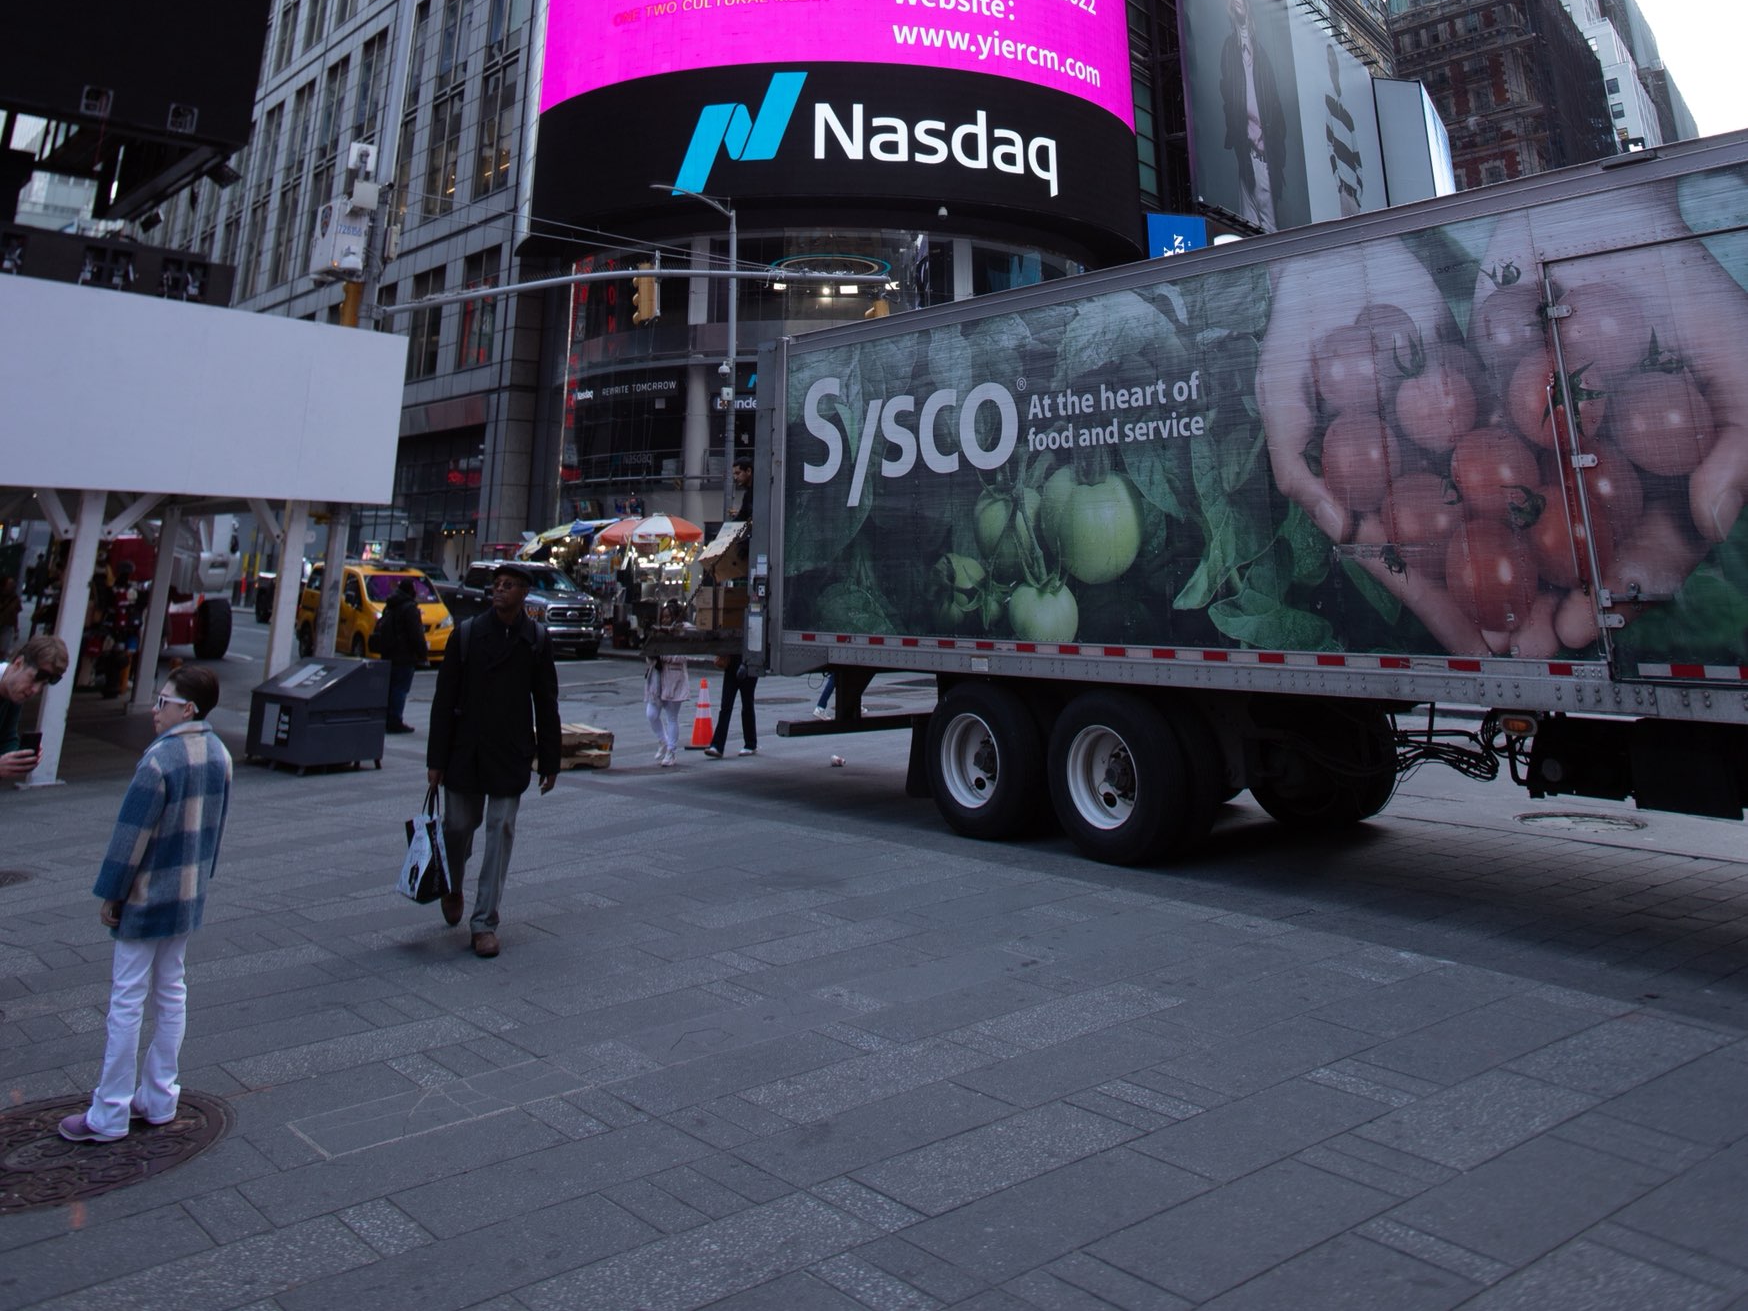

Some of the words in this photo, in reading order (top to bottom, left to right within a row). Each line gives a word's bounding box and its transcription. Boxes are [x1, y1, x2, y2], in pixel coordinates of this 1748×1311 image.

[646, 1, 678, 18] TWO
[892, 24, 1101, 88] www.yiercm.com
[814, 103, 1058, 197] Nasdaq
[602, 384, 629, 397] REWRITE
[1028, 394, 1052, 420] At
[1057, 389, 1094, 416] the
[1100, 379, 1167, 411] heart
[1173, 370, 1200, 402] of
[1028, 423, 1074, 452] food
[1079, 418, 1119, 447] and
[1124, 411, 1205, 442] service
